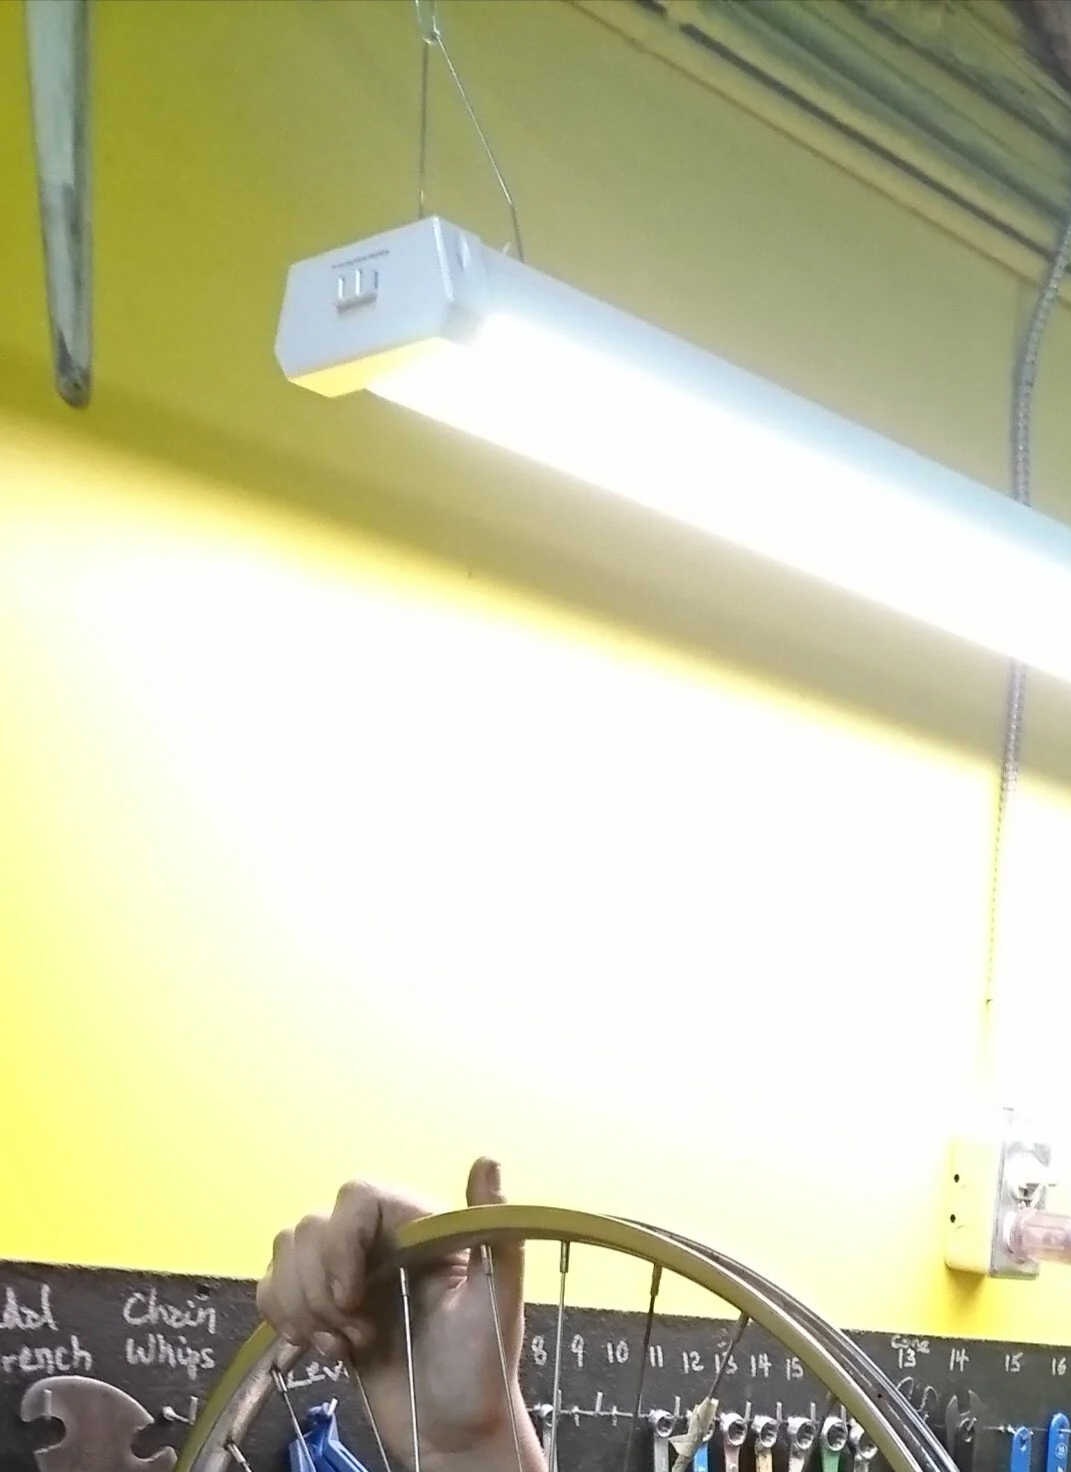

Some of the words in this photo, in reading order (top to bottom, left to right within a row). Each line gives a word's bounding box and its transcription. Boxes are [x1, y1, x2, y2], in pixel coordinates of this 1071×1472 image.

[0, 1283, 59, 1331] dal
[123, 1287, 216, 1335] Chain
[125, 1333, 216, 1381] Whips
[531, 1334, 548, 1366] 8
[571, 1333, 585, 1368] 9
[606, 1340, 629, 1364] 10
[649, 1345, 664, 1368] 11
[682, 1350, 705, 1374] 12
[714, 1351, 739, 1376] 13
[750, 1352, 773, 1378] 14
[785, 1356, 804, 1381] 15
[898, 1347, 917, 1369] 13
[949, 1347, 970, 1373] 14
[1005, 1352, 1024, 1372] 15
[1051, 1357, 1067, 1376] 16
